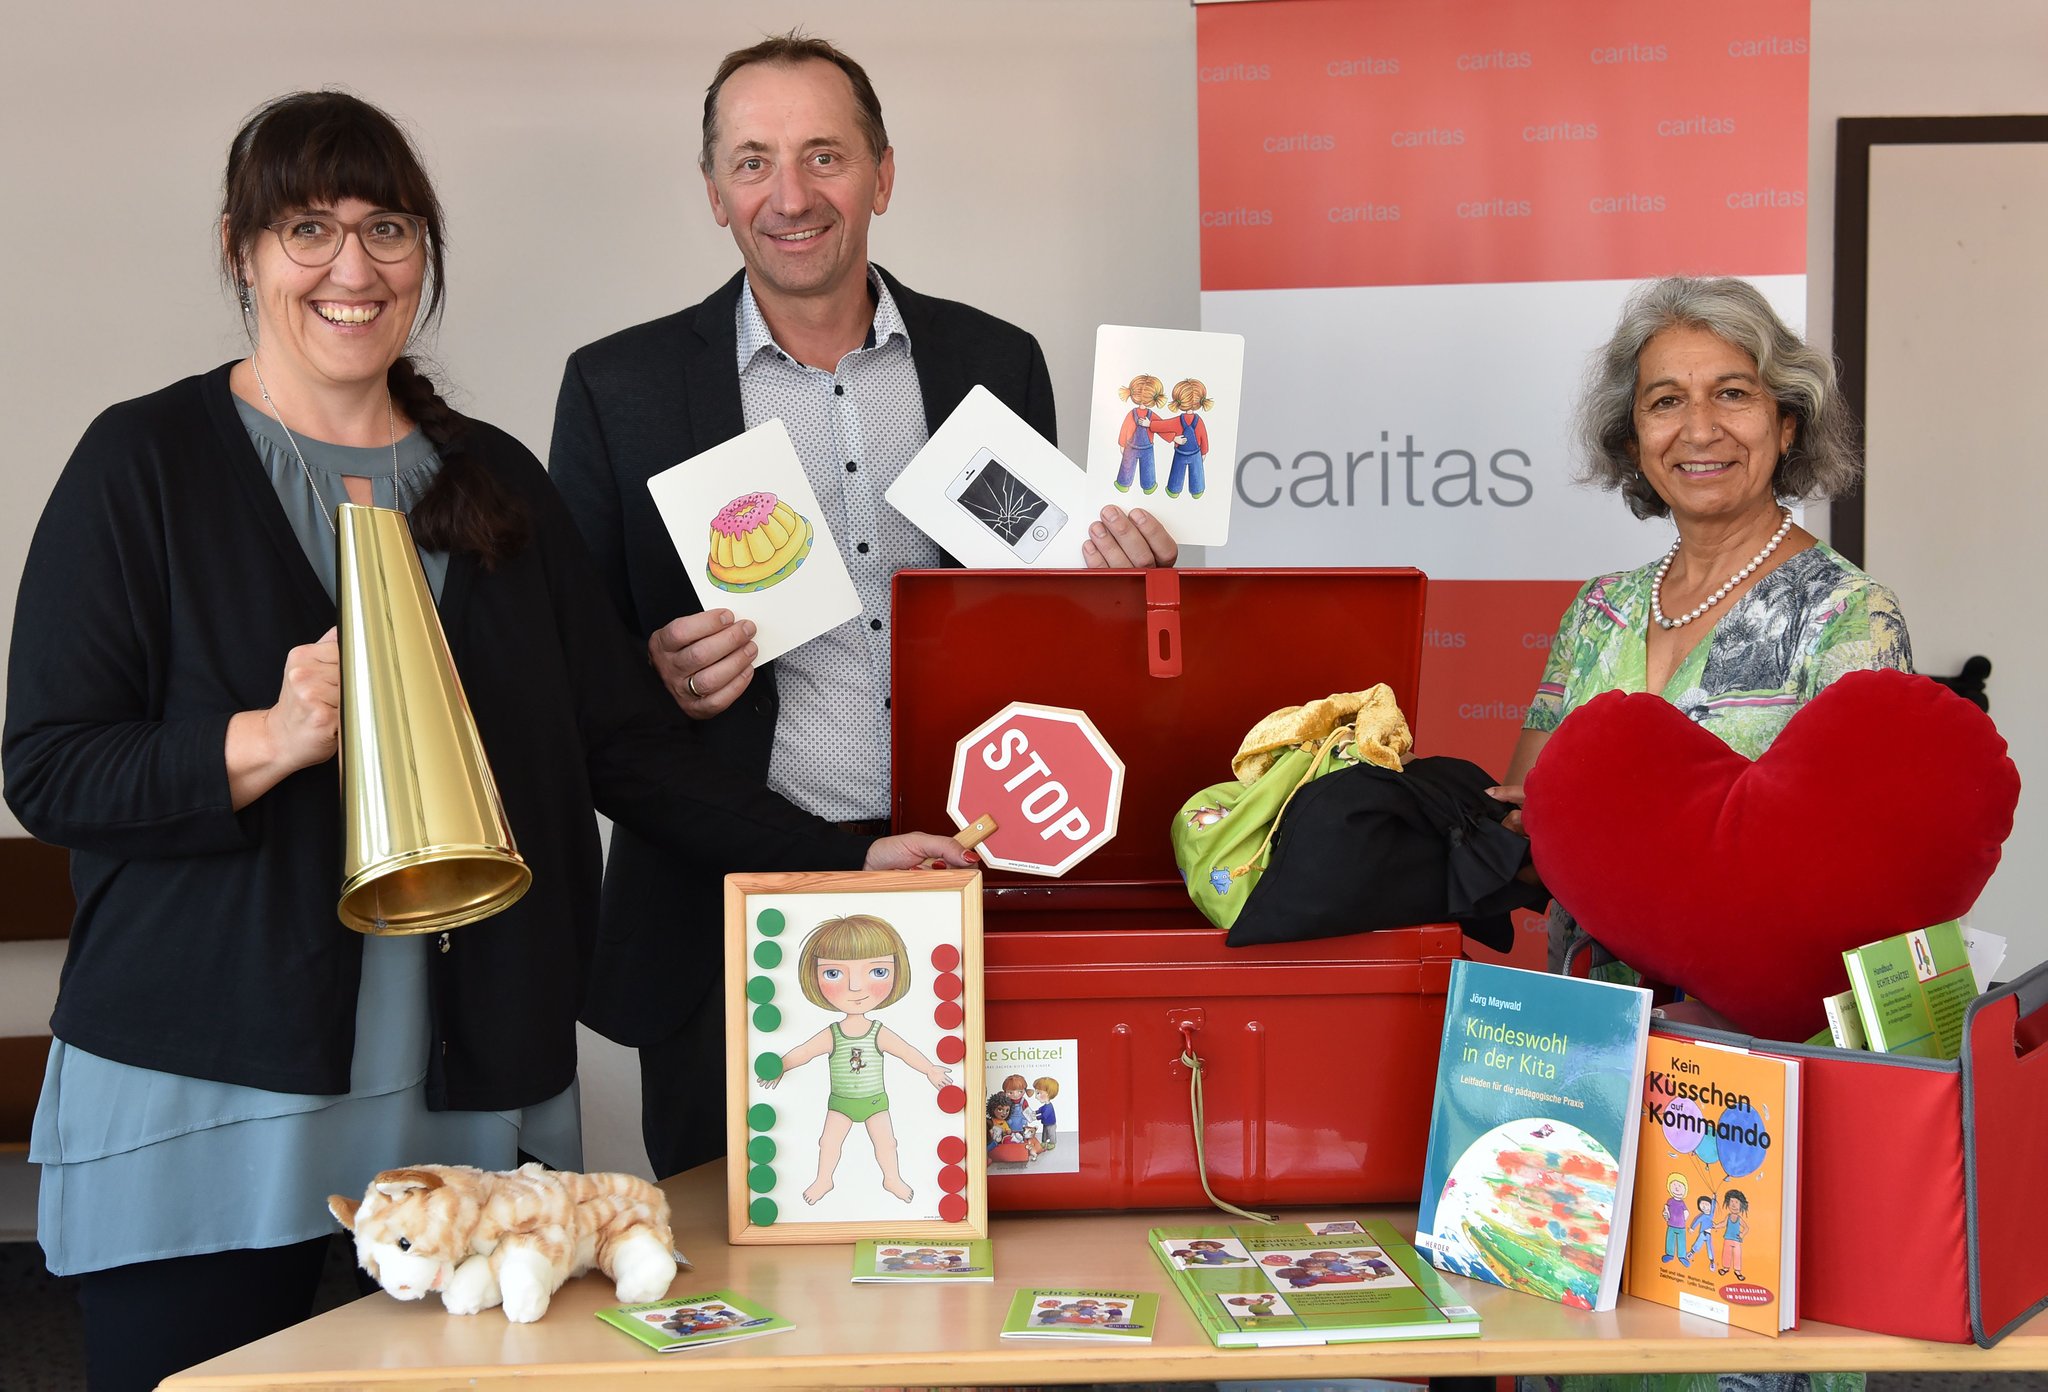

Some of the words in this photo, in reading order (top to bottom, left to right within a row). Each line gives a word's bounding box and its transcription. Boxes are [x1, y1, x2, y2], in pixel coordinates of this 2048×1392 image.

[1590, 42, 1668, 65] caritas
[1728, 35, 1807, 58] caritas
[1326, 56, 1400, 77] caritas
[1456, 49, 1532, 71] caritas
[1198, 62, 1271, 82] caritas
[1391, 126, 1465, 148] caritas
[1522, 120, 1598, 143] caritas
[1657, 115, 1735, 138] caritas
[1263, 132, 1335, 154] caritas
[1456, 196, 1532, 219] caritas
[1589, 191, 1667, 214] caritas
[1725, 187, 1805, 210] caritas
[1201, 207, 1273, 228] caritas
[1327, 201, 1400, 224] caritas
[1235, 431, 1534, 508] caritas
[982, 728, 1091, 841] STOP
[1470, 993, 1487, 1007] Jörg
[1488, 996, 1522, 1011] Maywald
[1466, 1017, 1567, 1055] Kindeswohl
[1001, 1047, 1062, 1061] Schätze!
[1463, 1042, 1478, 1064] in
[1484, 1047, 1514, 1070] der
[1519, 1053, 1555, 1079] Kita
[1671, 1057, 1700, 1075] Kein
[1460, 1074, 1490, 1089] Leitfaden
[1492, 1081, 1502, 1091] für
[1503, 1083, 1514, 1094] die
[1515, 1087, 1561, 1103] pädagogische
[1563, 1096, 1584, 1109] Praxis
[1649, 1070, 1750, 1113] Küsschen
[1670, 1103, 1684, 1111] auf
[1649, 1102, 1771, 1149] Kommando
[1425, 1240, 1450, 1253] HERDER
[1078, 1291, 1140, 1299] Schätze!
